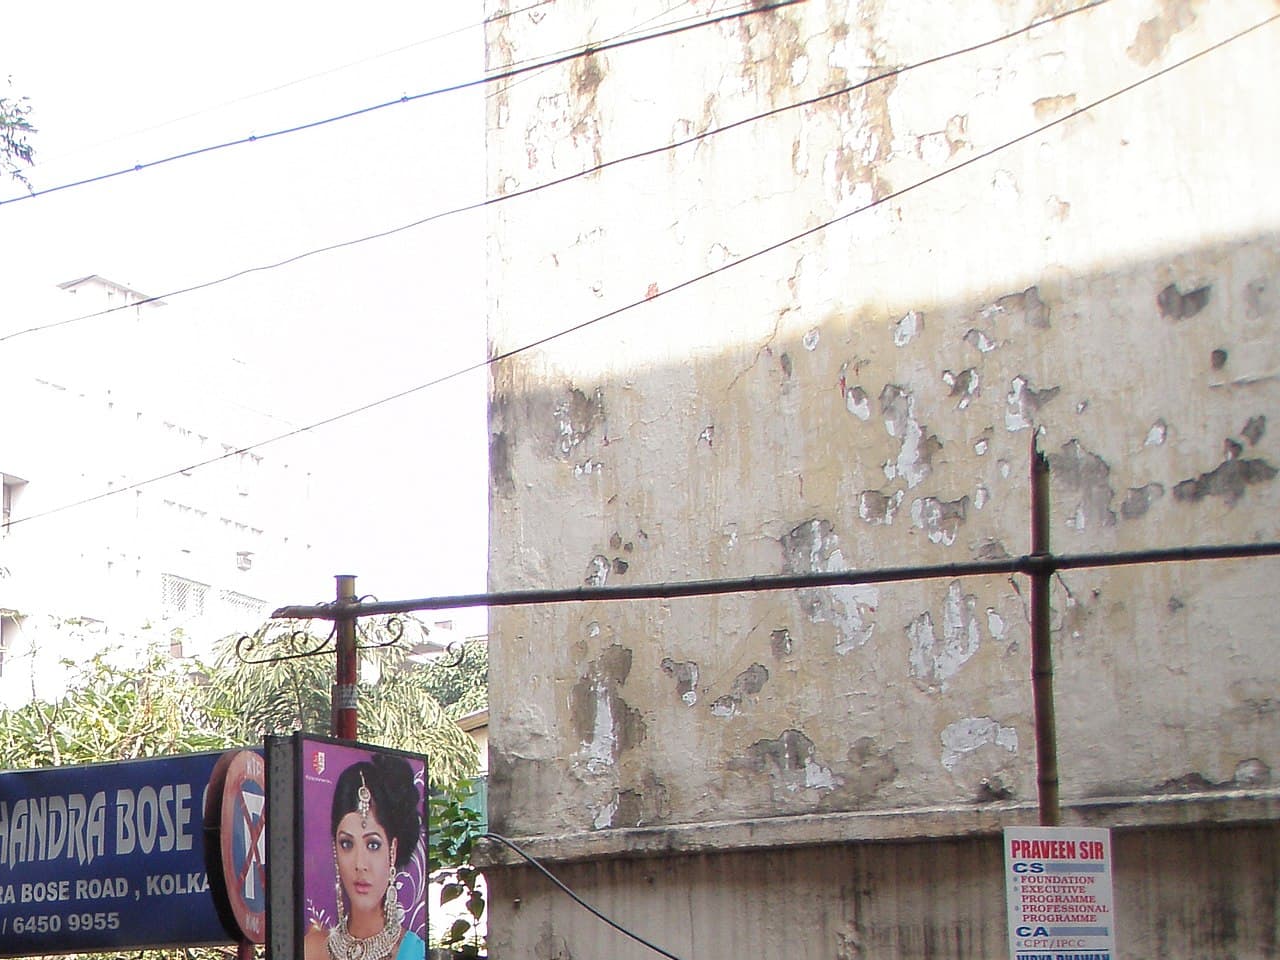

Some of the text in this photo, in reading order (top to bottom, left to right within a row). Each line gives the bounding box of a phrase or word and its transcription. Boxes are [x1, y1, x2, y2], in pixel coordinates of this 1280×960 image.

[116, 783, 192, 855] BOSE
[1011, 840, 1104, 859] PRAVEEN SIR
[1012, 863, 1045, 873] CS
[1020, 876, 1095, 884] FOUNDATION
[21, 881, 70, 903] BOSE
[76, 877, 129, 899] ROAD
[1021, 895, 1096, 903] PROGRAMME
[1022, 905, 1109, 913] PROFESSIONAL
[13, 914, 61, 934] 6450
[67, 912, 120, 931] 9955
[1023, 914, 1097, 922] PROGRAMME
[1015, 927, 1049, 937] CA
